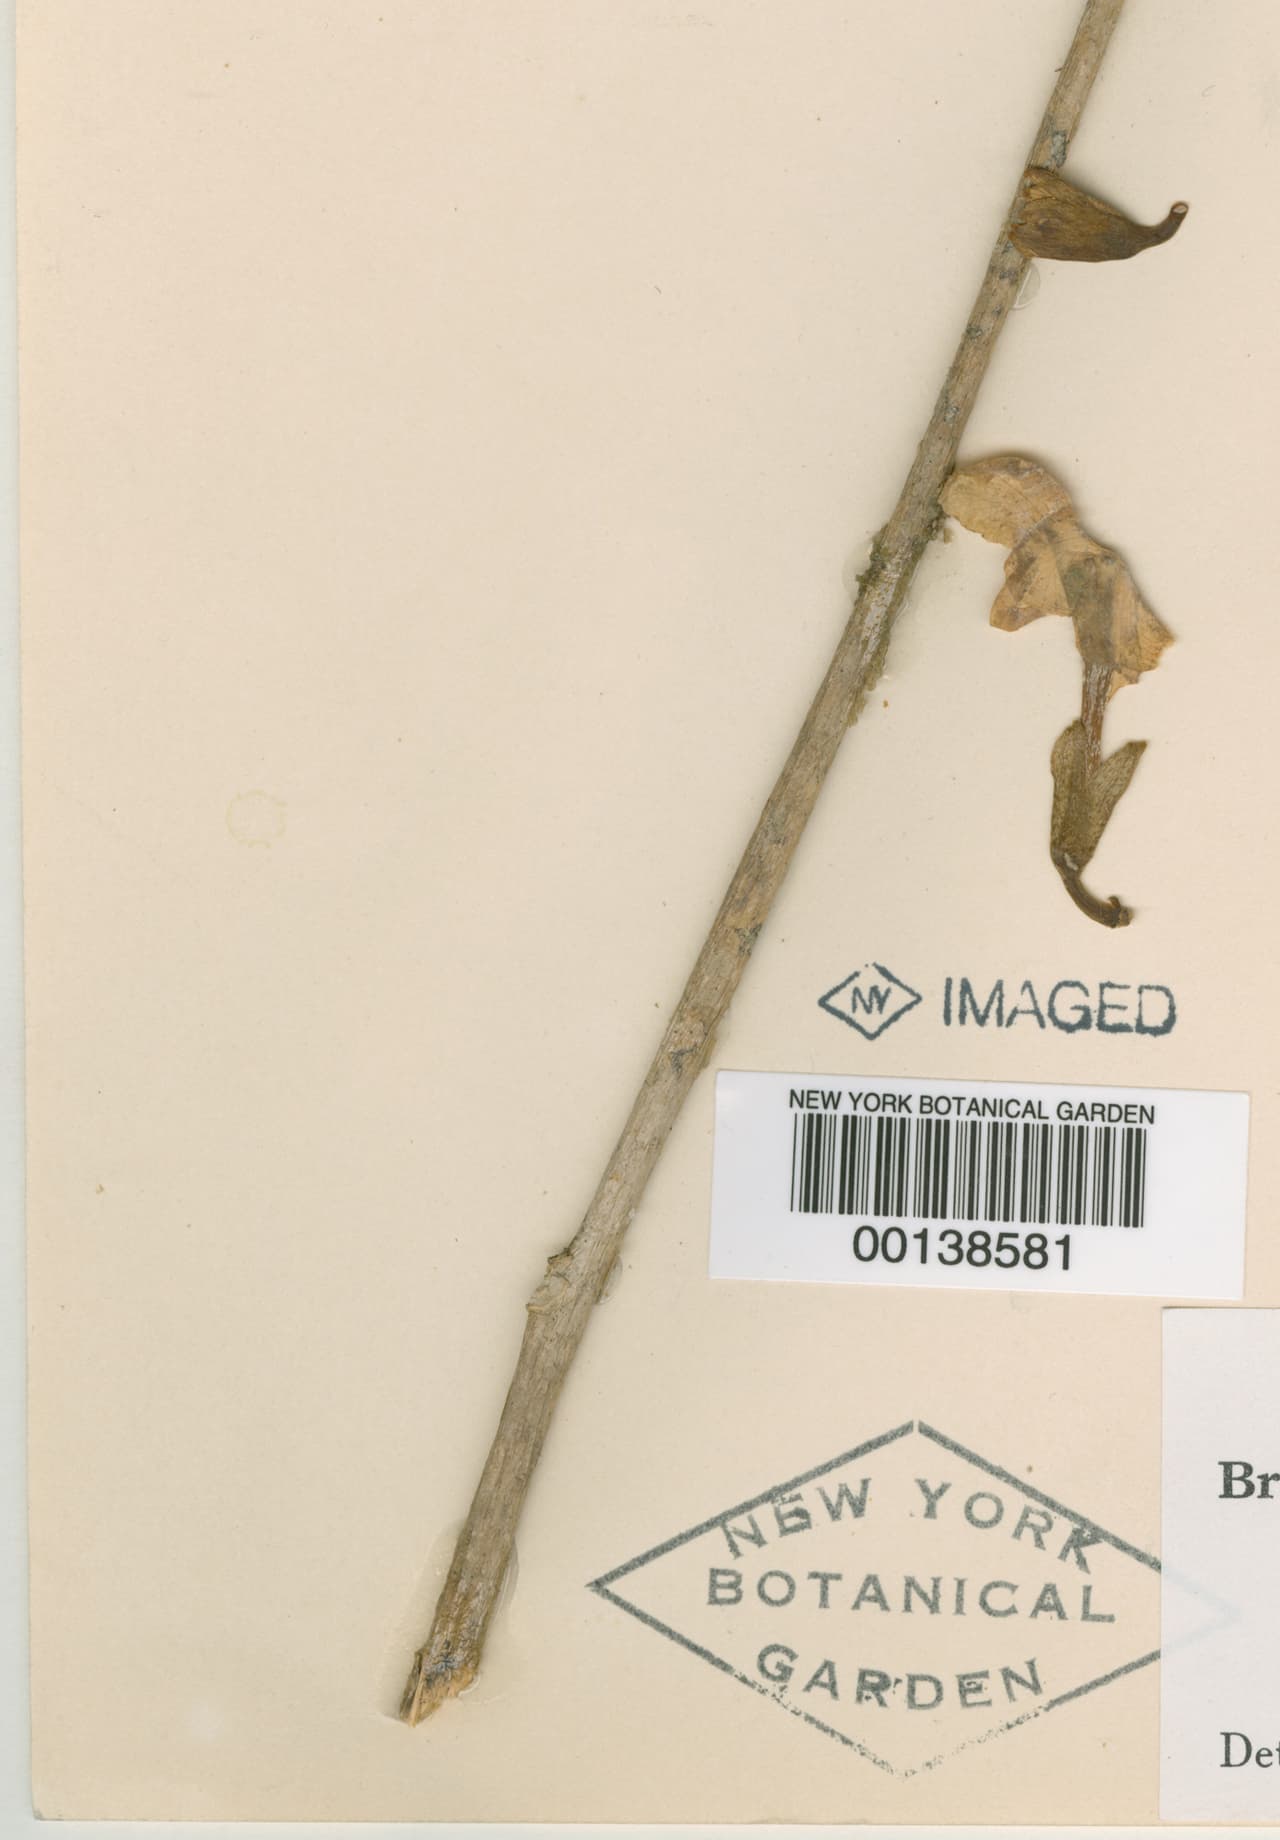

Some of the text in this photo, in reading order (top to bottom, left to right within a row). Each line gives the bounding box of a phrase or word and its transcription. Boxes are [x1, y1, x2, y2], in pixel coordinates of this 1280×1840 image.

[942, 976, 1177, 1038] IMAGED
[788, 1088, 1156, 1126] NEW YORK BOTANICAL GARDEN
[852, 1224, 1071, 1272] 00138581
[719, 1477, 1108, 1573] NEW YORK
[706, 1566, 1116, 1623] BOTANICAL
[753, 1640, 1052, 1714] GARDEN
